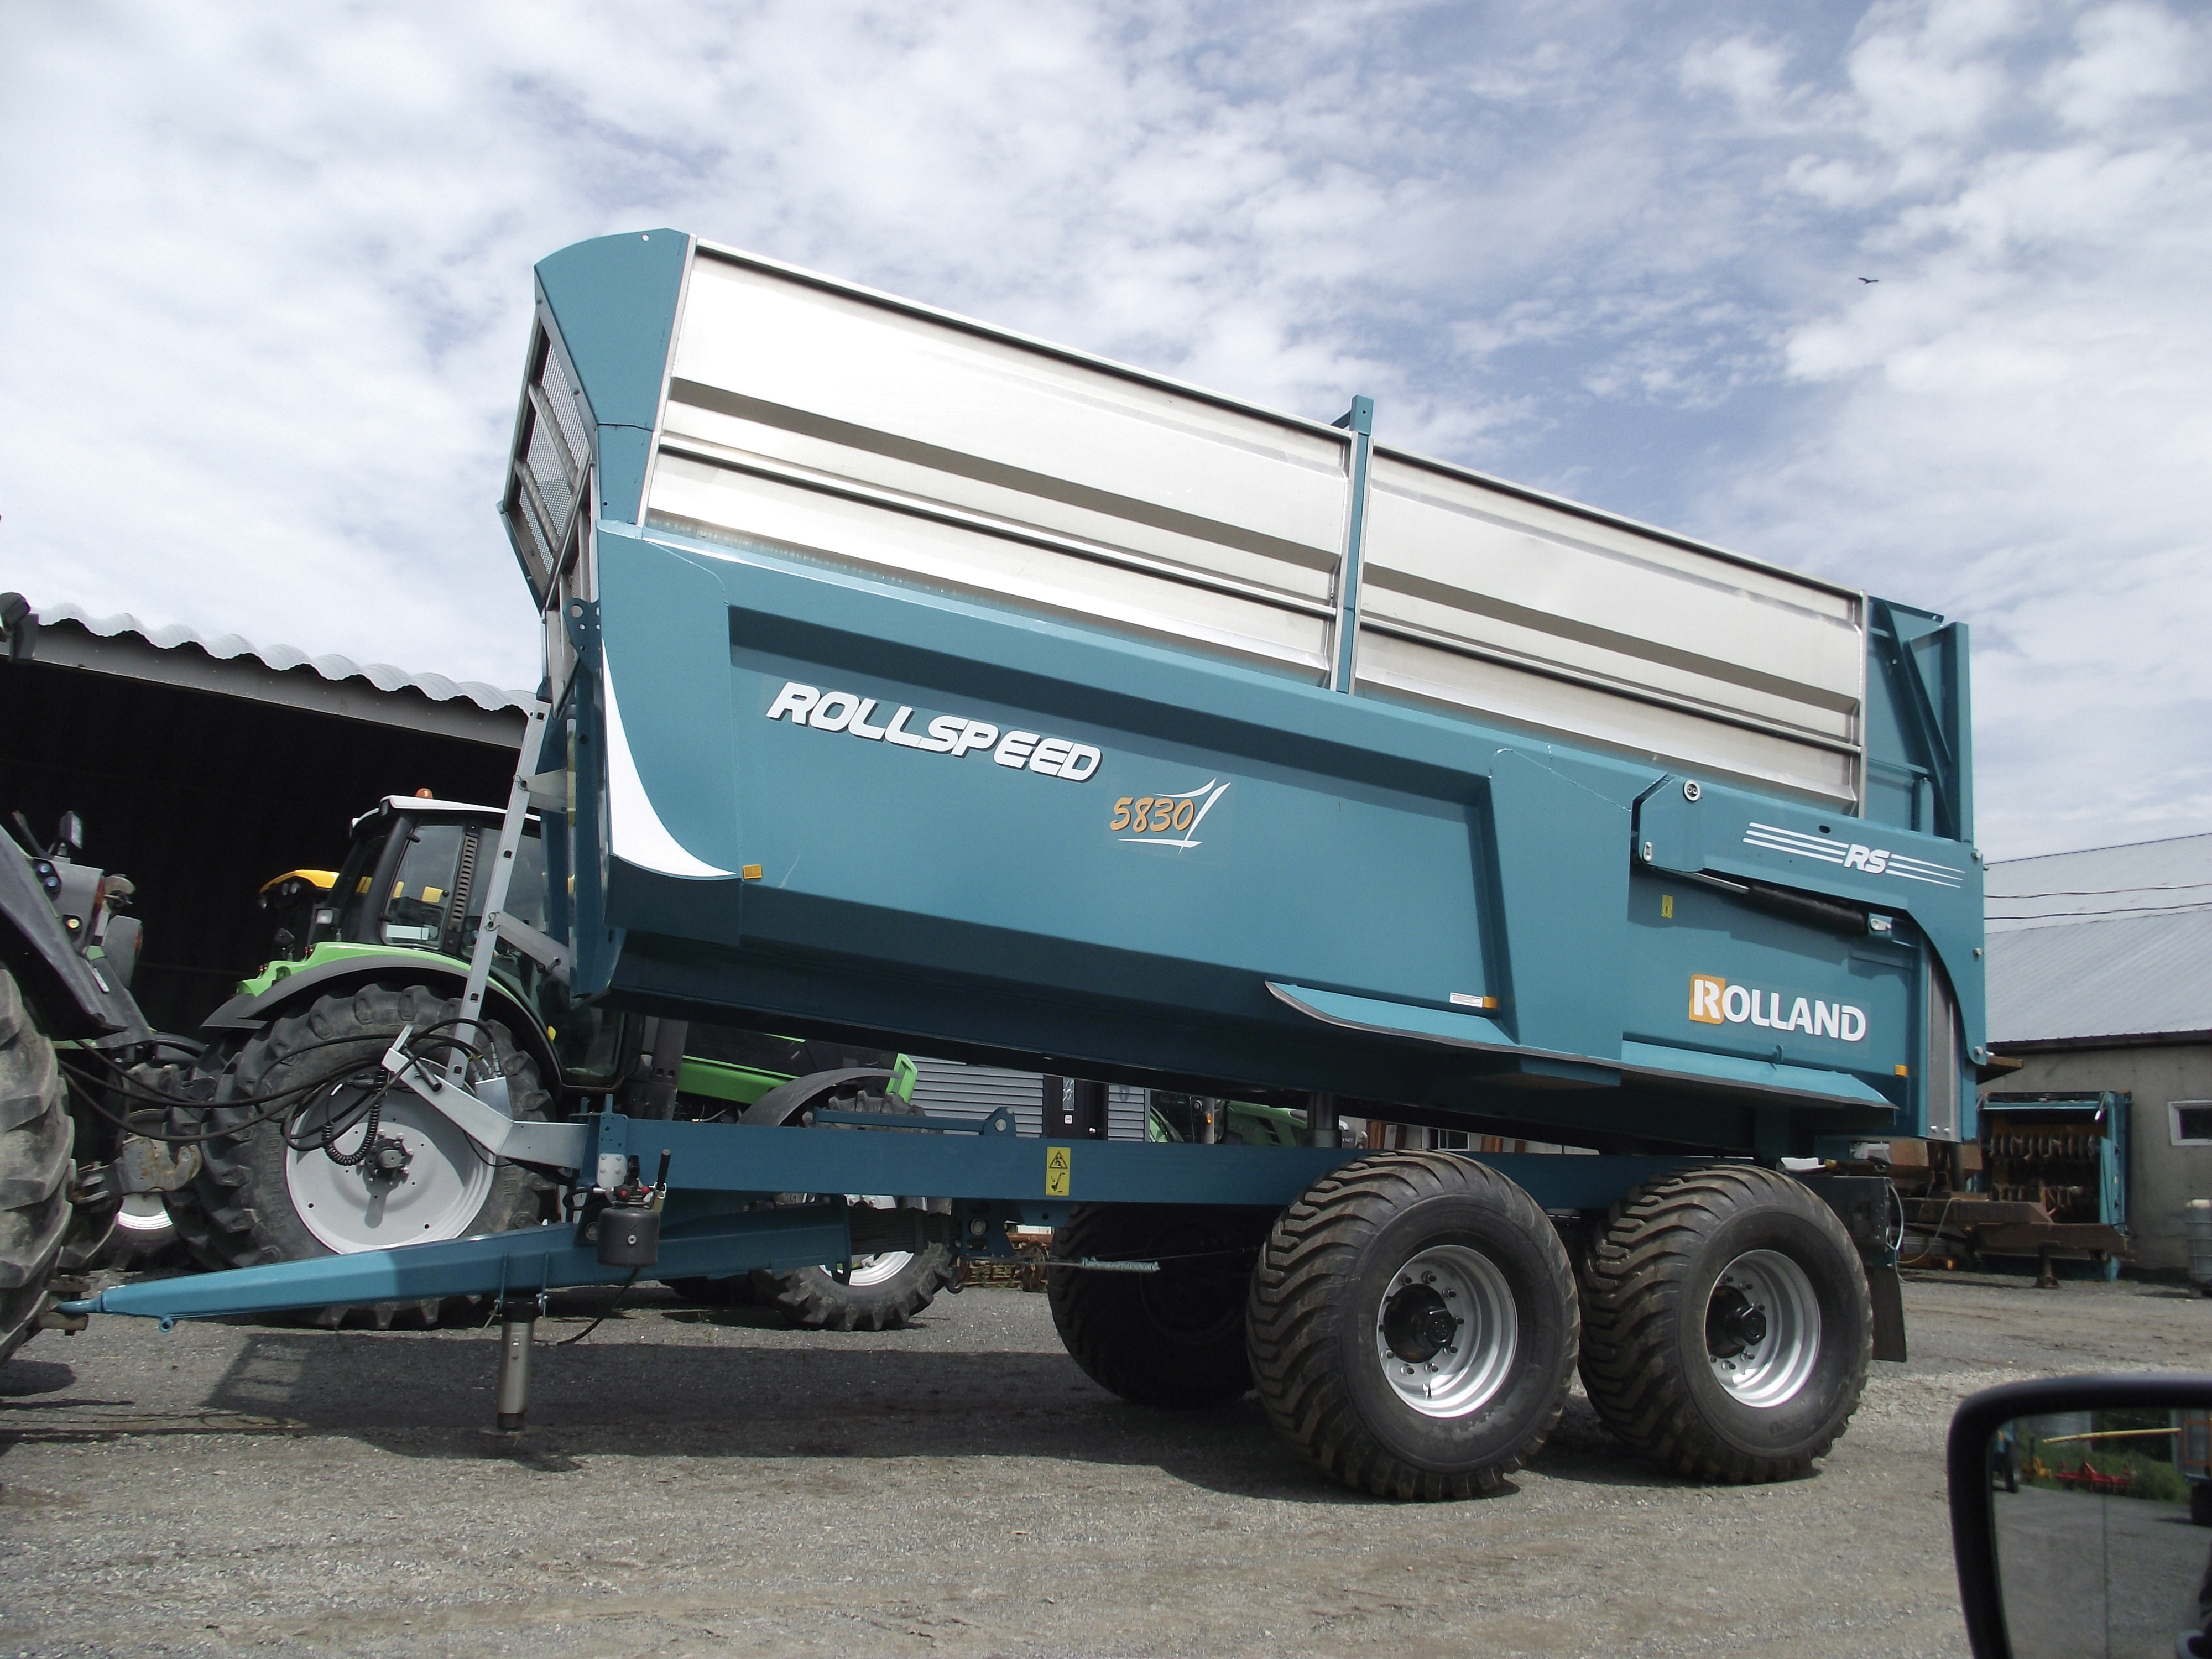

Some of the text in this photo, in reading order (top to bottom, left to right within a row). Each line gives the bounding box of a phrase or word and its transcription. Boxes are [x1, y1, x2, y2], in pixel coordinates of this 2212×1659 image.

[765, 681, 1103, 782] ROLLSPEED
[1110, 797, 1195, 833] 5830
[1844, 843, 1891, 874] RS
[1692, 977, 1866, 1042] ROLLAND
